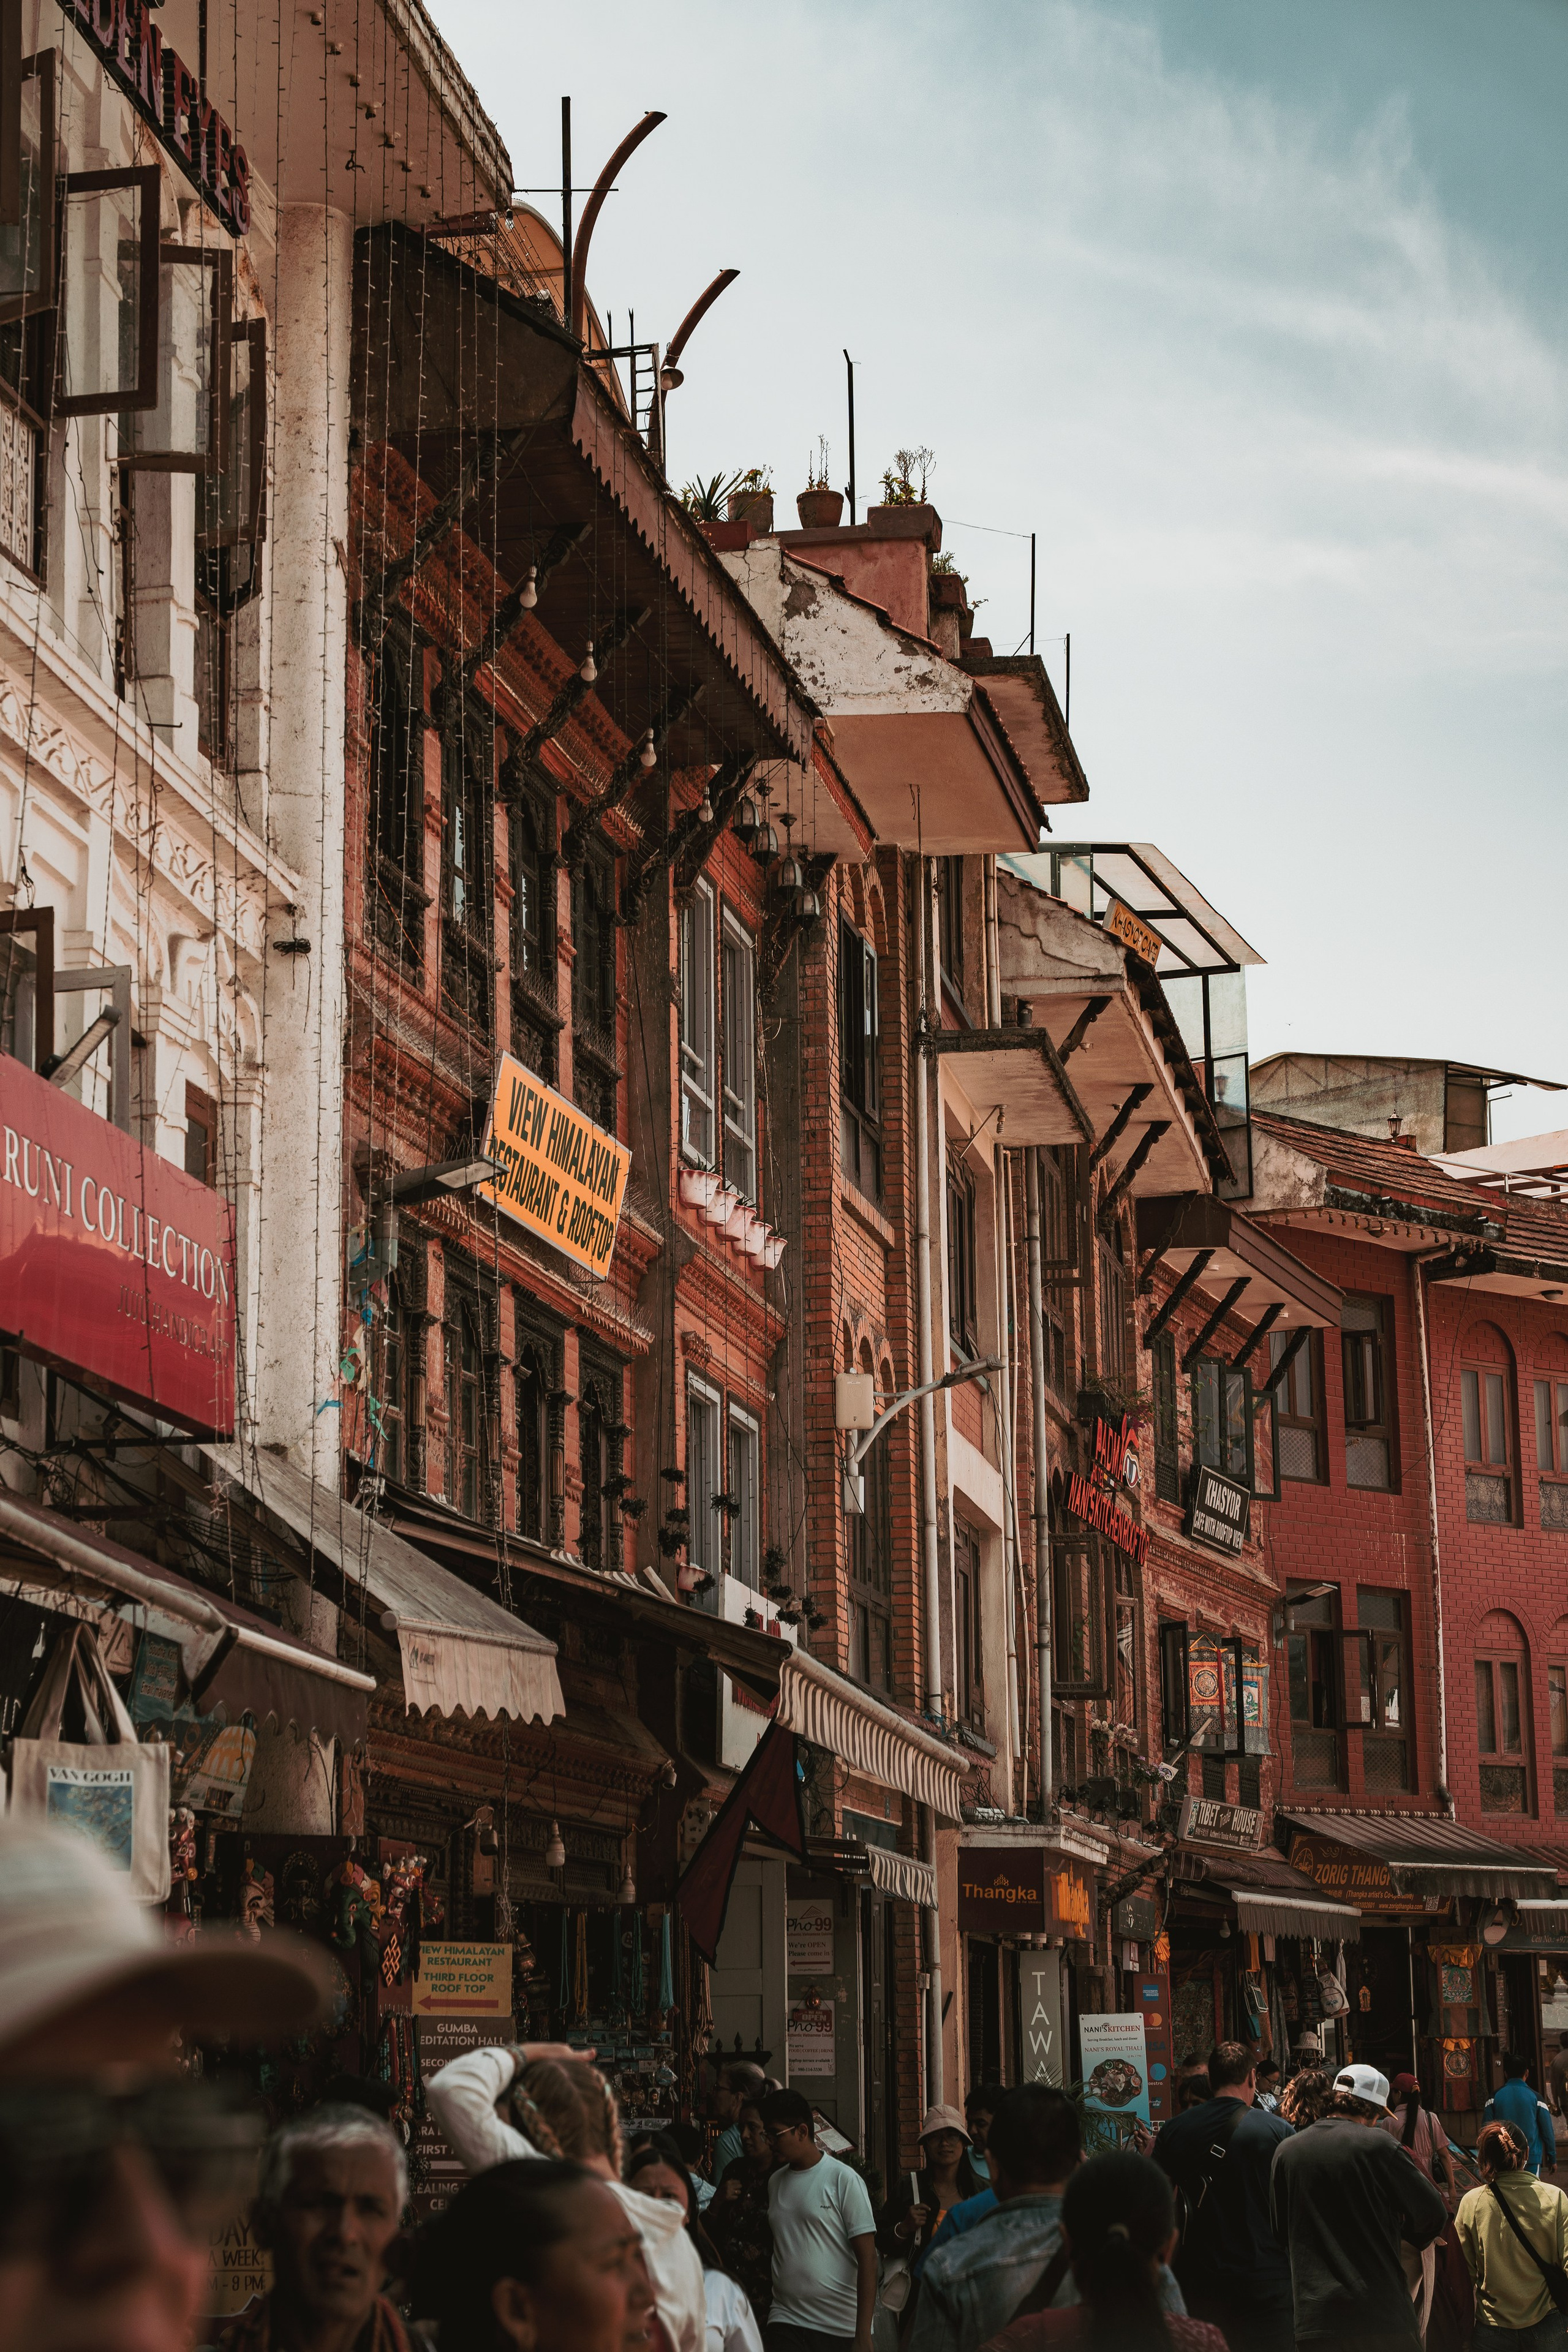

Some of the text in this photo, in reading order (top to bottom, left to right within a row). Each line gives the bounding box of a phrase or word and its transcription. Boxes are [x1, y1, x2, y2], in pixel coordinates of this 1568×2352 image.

[1114, 909, 1159, 962] KHASYOR CAFE
[508, 1076, 620, 1205] VIEW HIMALAYAN
[556, 1189, 570, 1235] &
[567, 1195, 615, 1264] ROOFTOP
[80, 1176, 230, 1309] COLLECTION
[118, 1285, 230, 1368] JUJU HANDICRAFT
[1205, 1477, 1242, 1521] KHASYOR
[1194, 1509, 1244, 1550] CAFE WITH ROOFTOP VIEW
[50, 1768, 131, 1782] VAN GOGH
[1198, 1801, 1221, 1827] TIBET
[1219, 1809, 1231, 1828] Trade
[1231, 1809, 1257, 1834] HOUSE
[1314, 1864, 1349, 1885] ZORIG
[962, 1883, 1037, 1903] Thangka
[1346, 1890, 1366, 1899] (Thangka
[444, 1946, 505, 1955] HIMALAYAN
[427, 1957, 492, 1966] RESTAURANT
[424, 1972, 494, 1982] THIRD FLOOR
[431, 1984, 486, 1993] ROOF TOP
[437, 2023, 478, 2034] GUMBA
[420, 2035, 505, 2046] EDITATION HALL
[420, 2059, 454, 2067] SECON
[417, 2145, 448, 2154] FIRST
[417, 2183, 459, 2194] EALING
[222, 2248, 260, 2266] WEEK
[245, 2275, 263, 2291] PM
